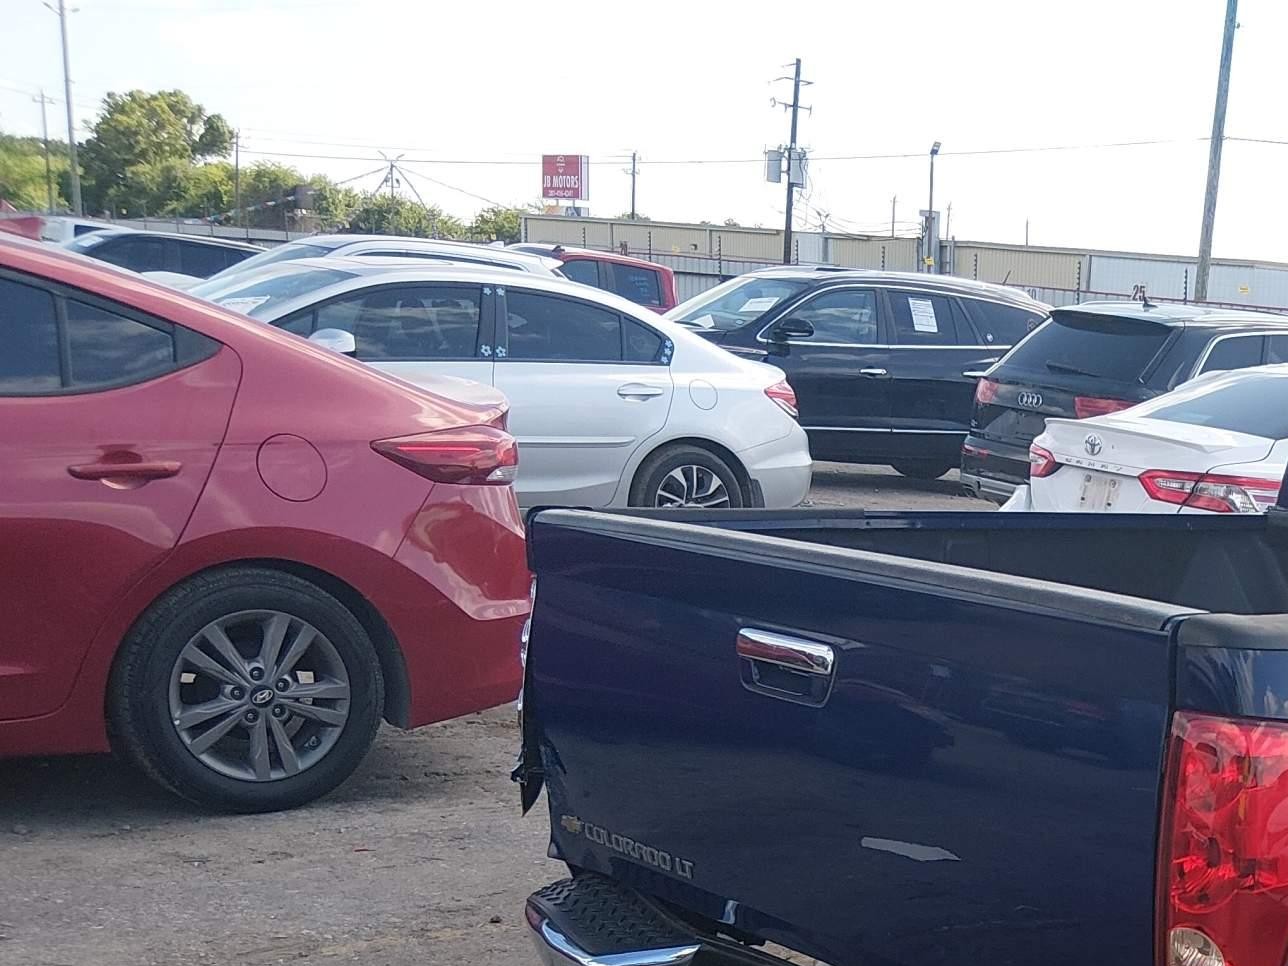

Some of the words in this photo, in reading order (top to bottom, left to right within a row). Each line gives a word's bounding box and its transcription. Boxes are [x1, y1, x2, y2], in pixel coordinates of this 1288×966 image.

[543, 175, 552, 188] JB
[552, 175, 579, 188] MOTORS
[584, 822, 672, 871] COLORADO
[675, 857, 694, 880] LT
